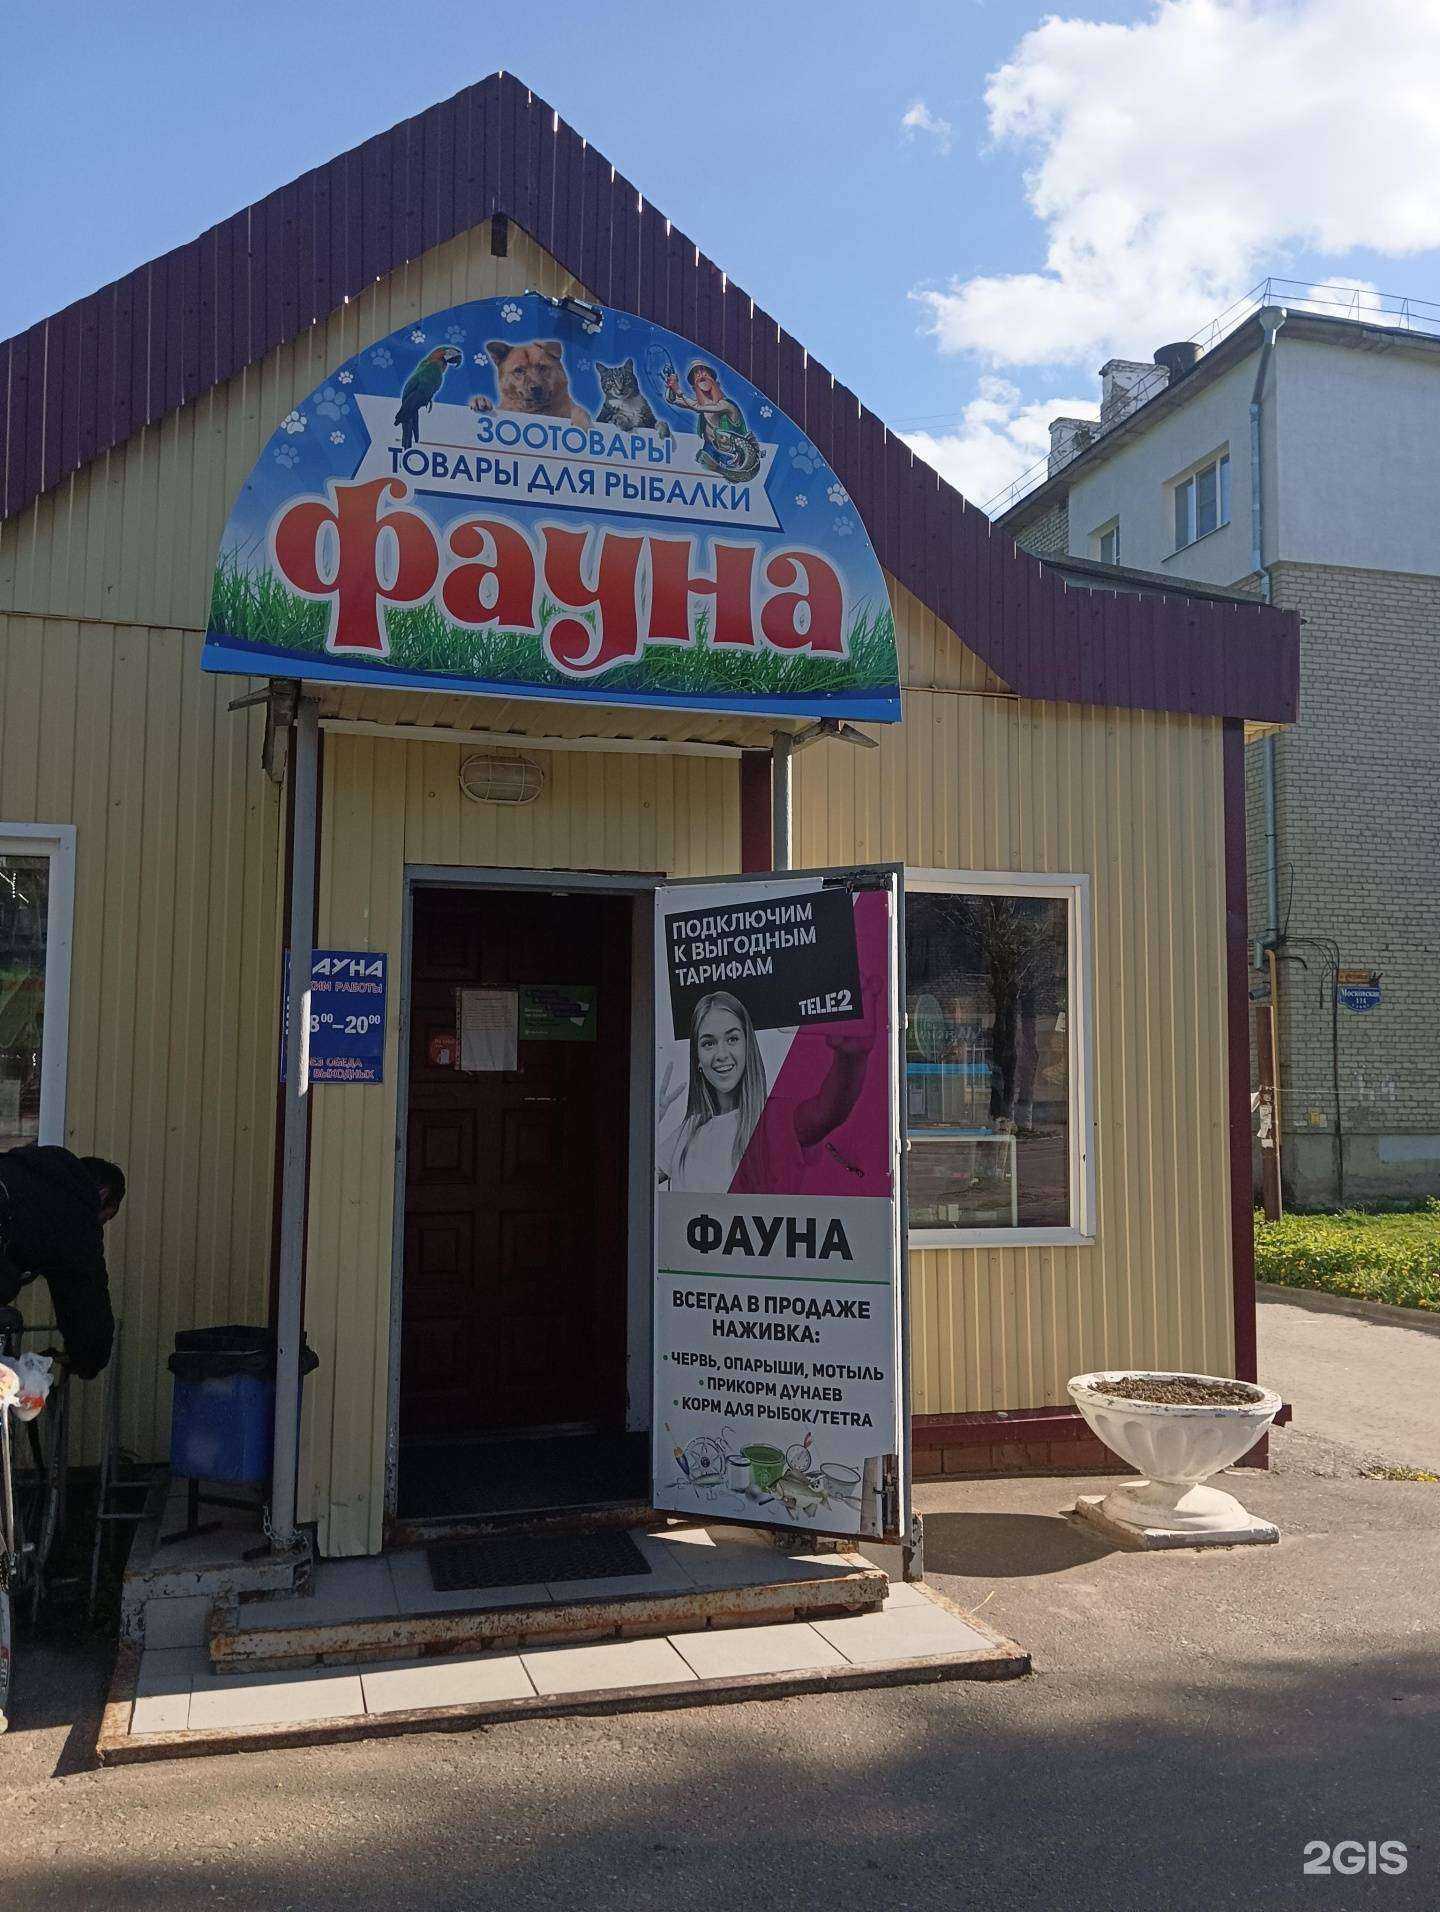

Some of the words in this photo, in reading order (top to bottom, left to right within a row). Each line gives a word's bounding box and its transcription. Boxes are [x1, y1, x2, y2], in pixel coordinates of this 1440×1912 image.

[476, 417, 672, 464] ЗООТОВАРЫ
[388, 445, 520, 487] ТОВАРЫ
[527, 467, 596, 496] ДЛЯ
[604, 472, 751, 512] РЫБАЛКИ
[672, 902, 813, 940] ПОДКЛЮЧИМ
[674, 945, 687, 963] К
[692, 925, 817, 961] ВЫГОДНЫМ
[312, 958, 383, 978] АУНА
[675, 956, 773, 987] ТАРИФАМ
[335, 982, 383, 994] РАБОТЫ
[799, 989, 853, 1016] TELE2
[309, 1056, 323, 1067] ЕЗ
[686, 1214, 854, 1261] ФАУНА
[672, 1290, 743, 1313] ВСЕГДА
[747, 1295, 760, 1313] В
[764, 1296, 871, 1320] ПРОДАЖЕ
[712, 1319, 820, 1344] НАЖИВКА:
[671, 1351, 721, 1371] ЧЕРВЬ,
[724, 1356, 809, 1379] ОПАРЫШИ,
[812, 1363, 884, 1381] МОТЫЛЬ
[707, 1377, 776, 1397] ПРИКОРМ
[779, 1386, 843, 1402] ДУНАЕВ
[682, 1396, 722, 1413] КОРМ
[724, 1401, 754, 1417] ДЛЯ
[757, 1404, 873, 1427] РЫБОК/TETRA
